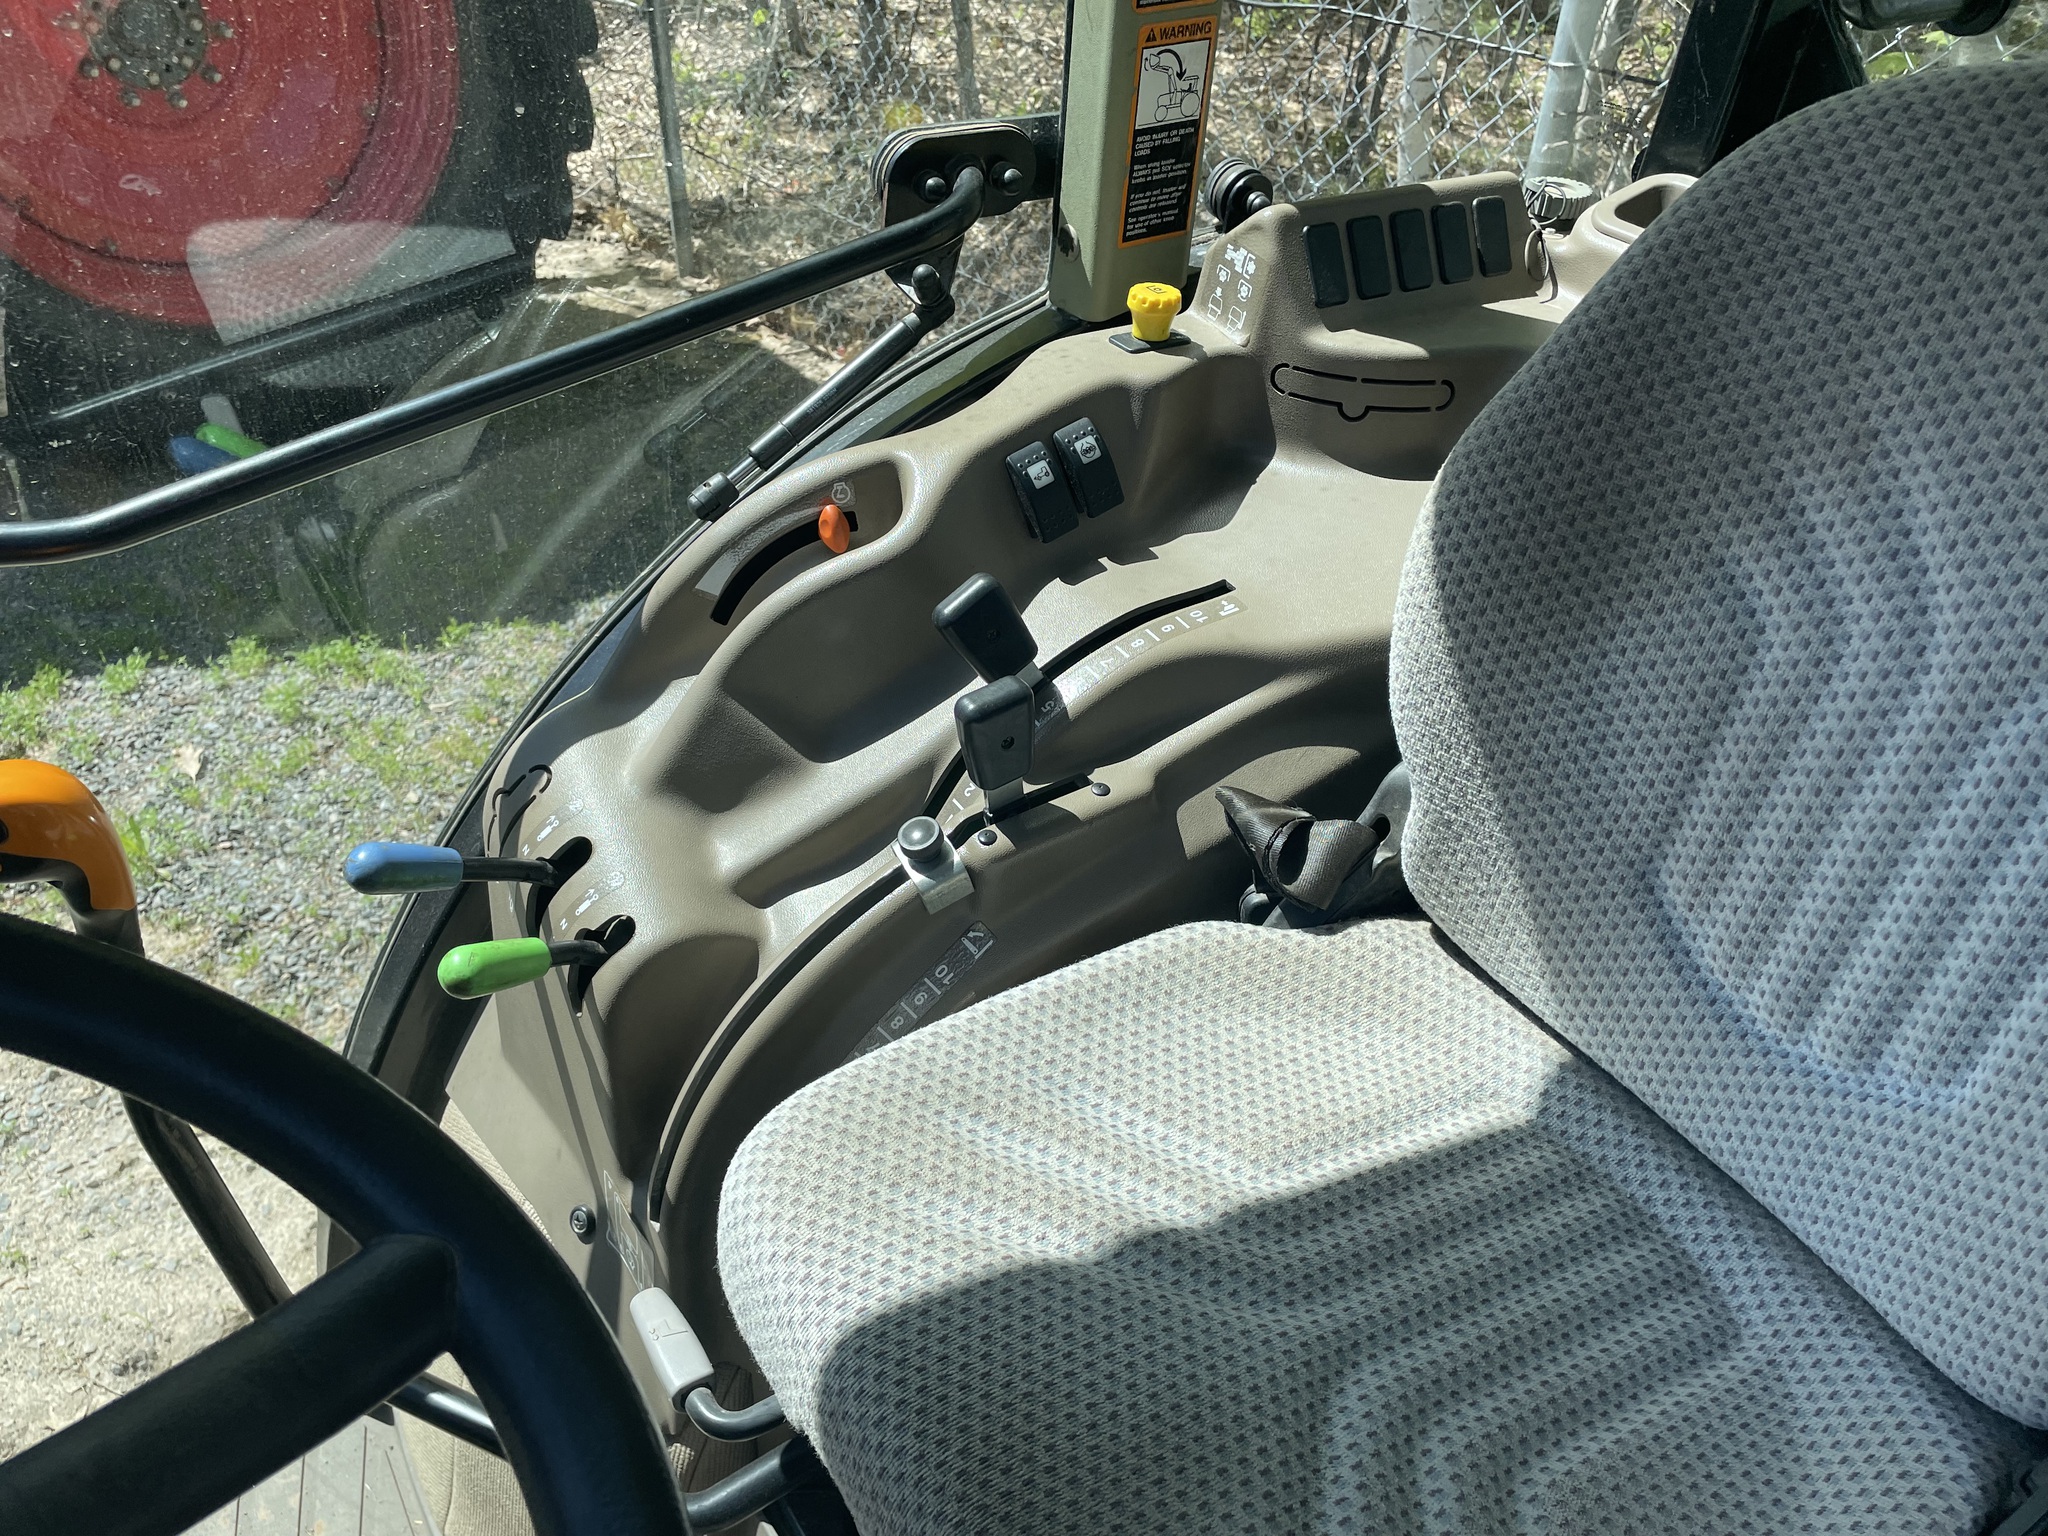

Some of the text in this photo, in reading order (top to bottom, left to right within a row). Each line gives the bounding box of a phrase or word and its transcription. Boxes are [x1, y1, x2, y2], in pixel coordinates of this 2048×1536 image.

[1160, 21, 1212, 40] WARNING
[1152, 131, 1169, 140] INJURY
[1179, 127, 1195, 135] DEATH
[1135, 141, 1154, 149] CAUSED
[1162, 136, 1181, 145] FALLING
[1132, 169, 1151, 177] ALWAYS
[1189, 609, 1209, 624] 10
[1130, 638, 1145, 649] 8
[1041, 700, 1055, 713] 5
[964, 782, 976, 797] 2
[934, 964, 954, 985] 10
[890, 1015, 904, 1030] 8
